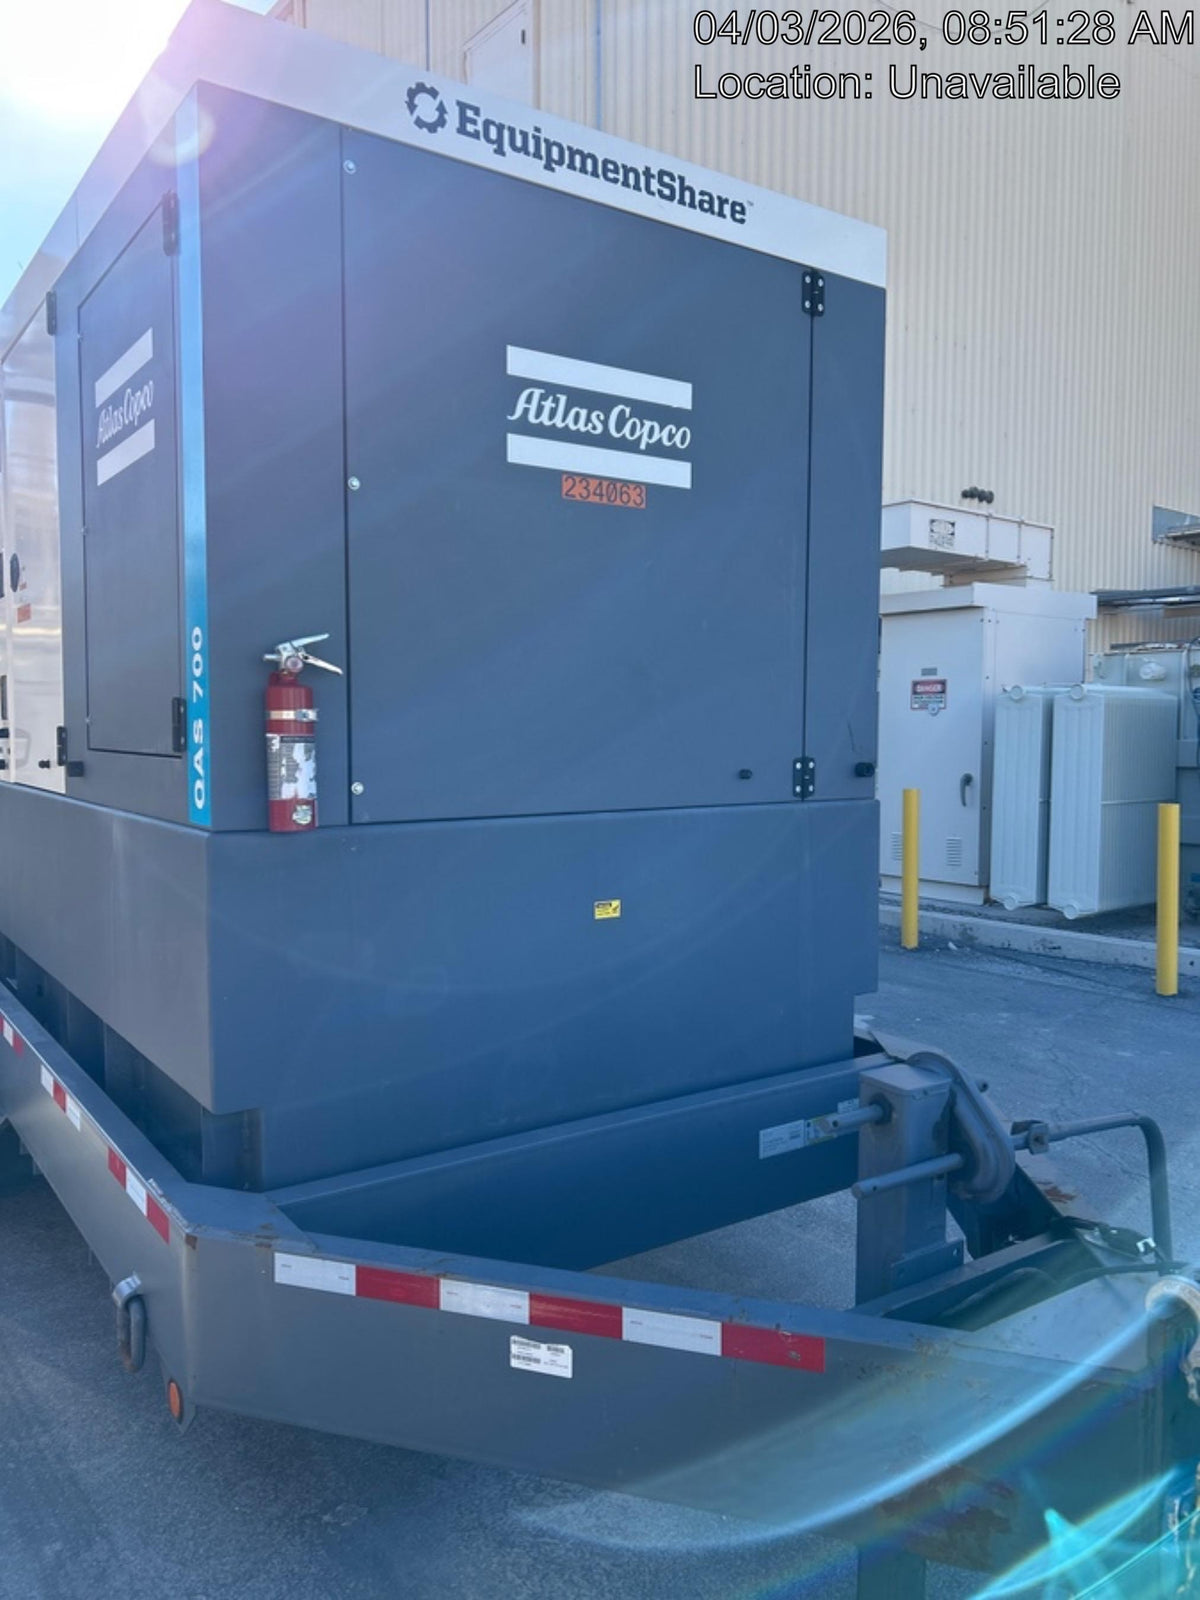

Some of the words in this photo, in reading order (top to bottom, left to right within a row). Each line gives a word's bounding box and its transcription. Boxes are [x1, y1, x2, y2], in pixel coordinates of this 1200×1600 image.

[455, 100, 747, 225] EquipmentShare
[506, 387, 605, 435] Atlas
[607, 404, 691, 450] Copco
[563, 475, 645, 507] 234063
[191, 626, 204, 703] 700
